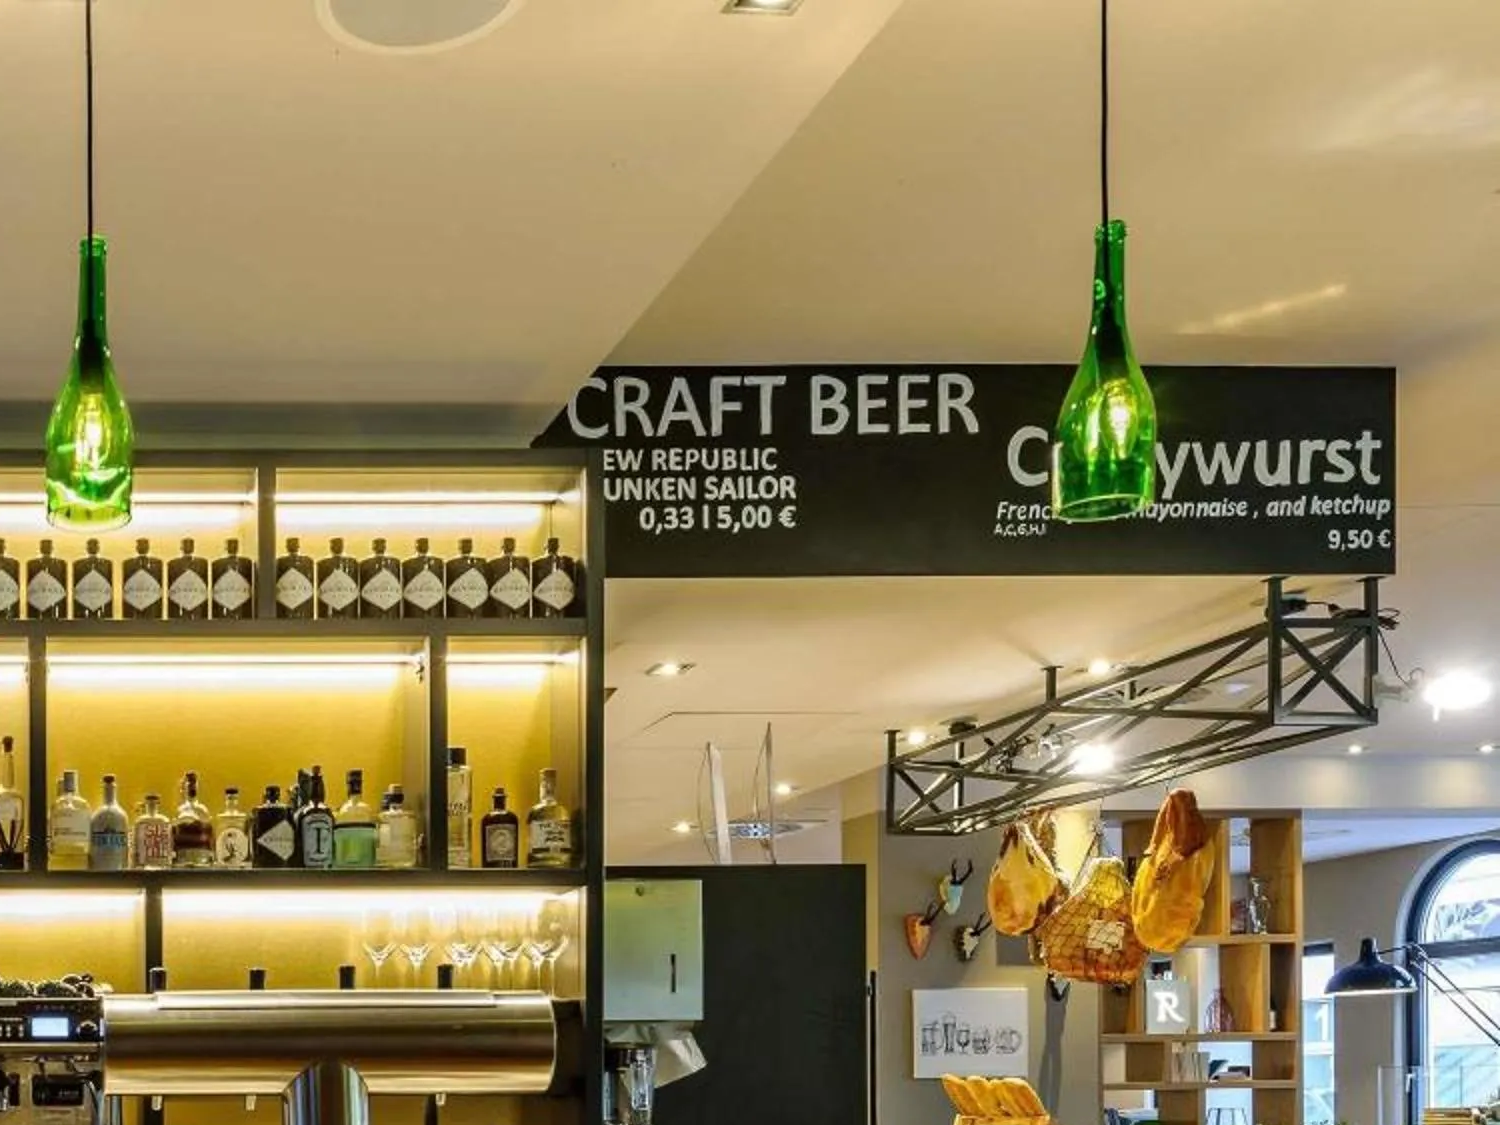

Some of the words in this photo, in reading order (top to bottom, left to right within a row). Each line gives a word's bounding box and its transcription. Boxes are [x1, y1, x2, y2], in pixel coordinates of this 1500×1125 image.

[567, 375, 787, 439] CRAFT
[810, 373, 979, 435] BEER
[602, 448, 644, 471] EW
[651, 447, 778, 471] REPUBLIC
[1007, 425, 1382, 499] Cywurst
[602, 476, 697, 502] UNKEN
[704, 475, 797, 501] SAILOR
[639, 505, 695, 535] 0,33
[716, 504, 773, 534] 5,00
[778, 505, 797, 529] €
[996, 501, 1057, 521] Frenc
[1265, 495, 1307, 517] and
[1309, 493, 1391, 521] ketchup
[1327, 528, 1374, 551] 9,50
[1377, 528, 1391, 549] €
[1152, 990, 1186, 1022] R
